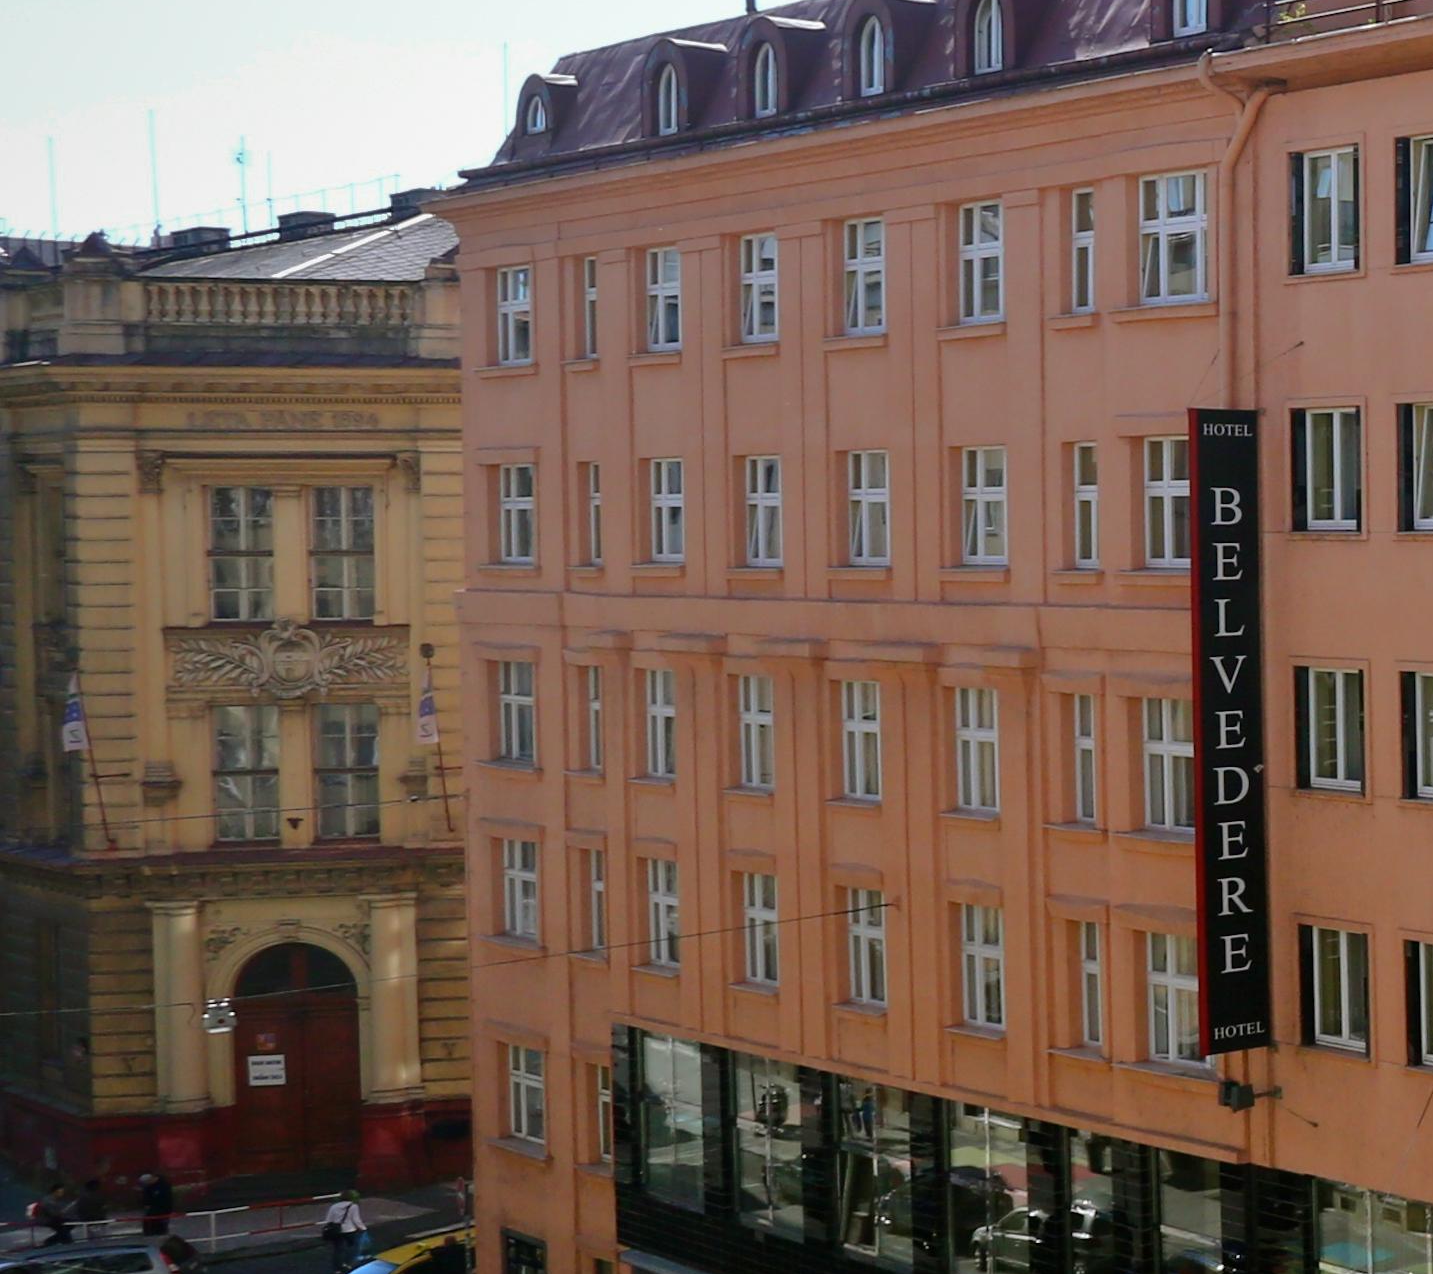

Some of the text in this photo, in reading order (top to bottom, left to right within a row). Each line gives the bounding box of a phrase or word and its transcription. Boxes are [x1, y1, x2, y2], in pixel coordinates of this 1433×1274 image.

[1202, 422, 1253, 438] HOTEL
[1209, 485, 1254, 976] BELVEDERE
[1213, 1019, 1266, 1042] HOTEL
